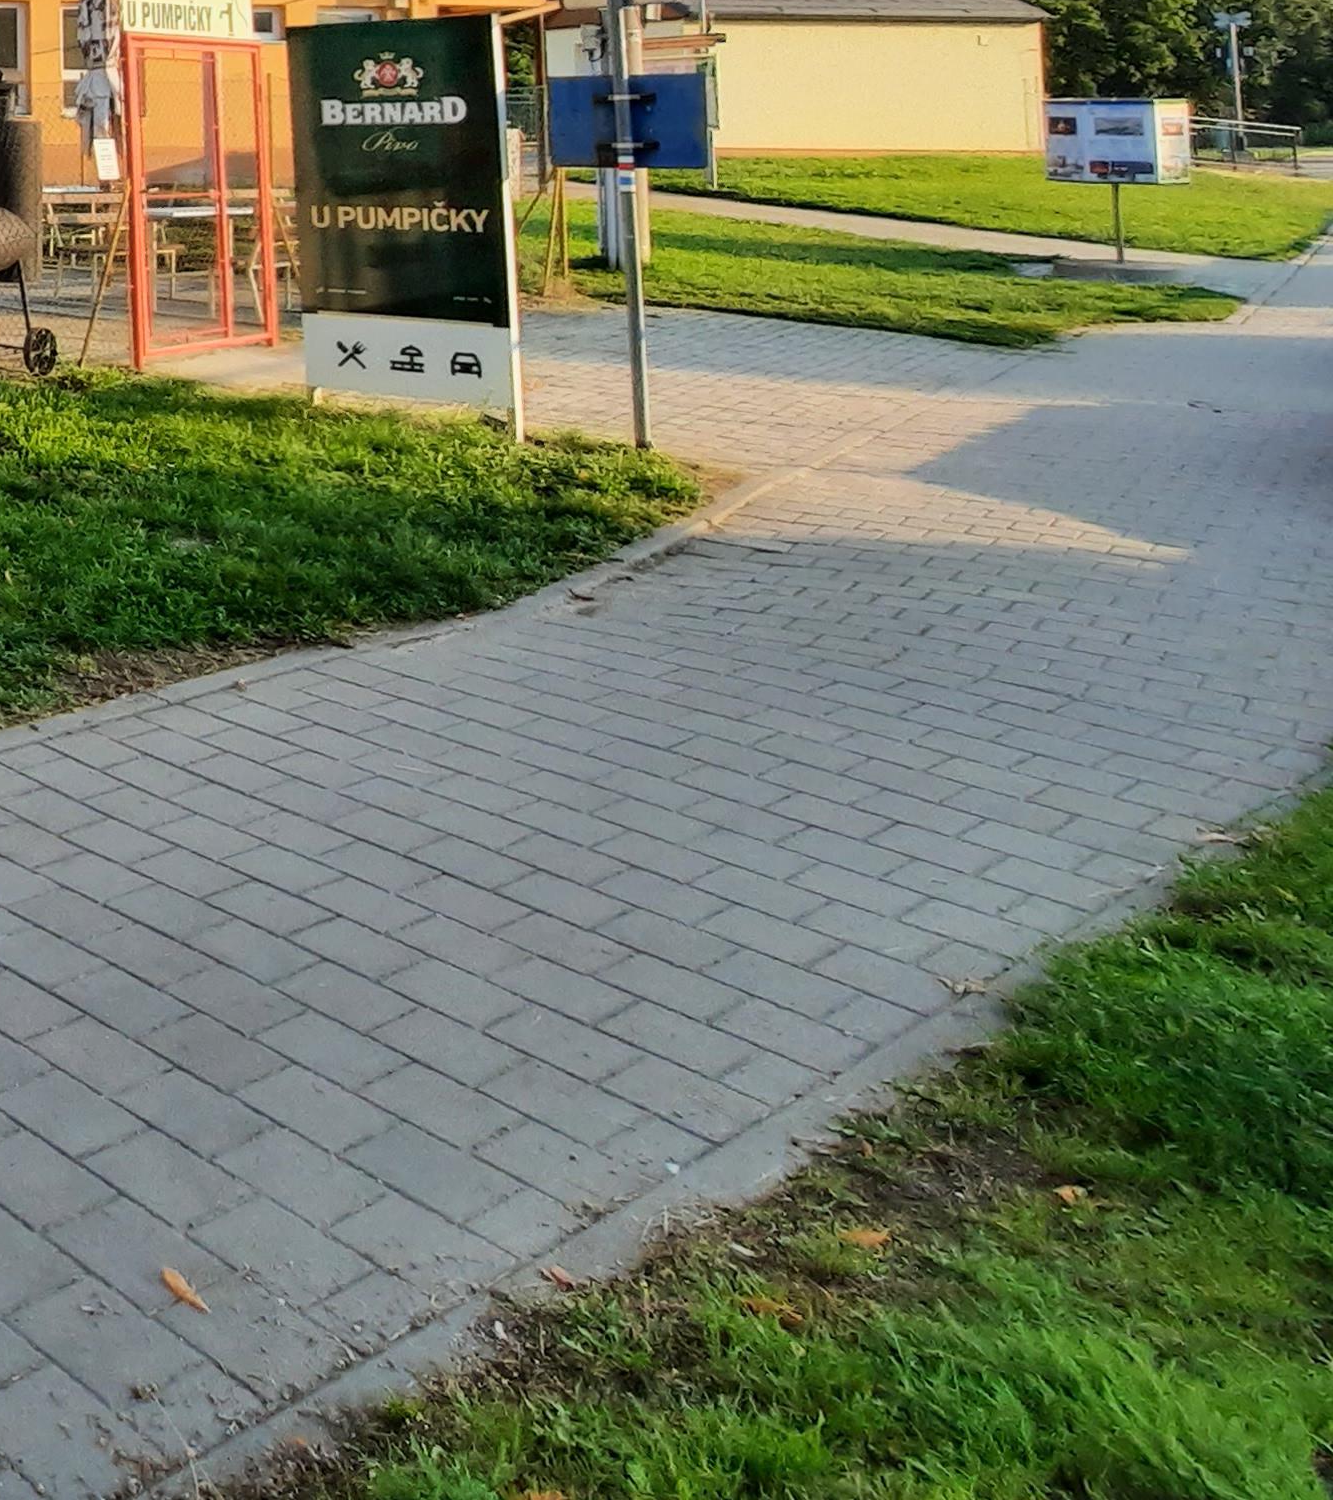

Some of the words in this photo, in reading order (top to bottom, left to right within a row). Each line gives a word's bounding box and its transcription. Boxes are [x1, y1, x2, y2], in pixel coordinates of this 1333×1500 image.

[127, 0, 137, 27] U
[141, 0, 212, 32] PUMPIČKY
[320, 95, 468, 126] BERNARD
[361, 127, 420, 152] Pivo
[310, 204, 331, 229] U
[337, 200, 489, 233] PUMPIČKY
